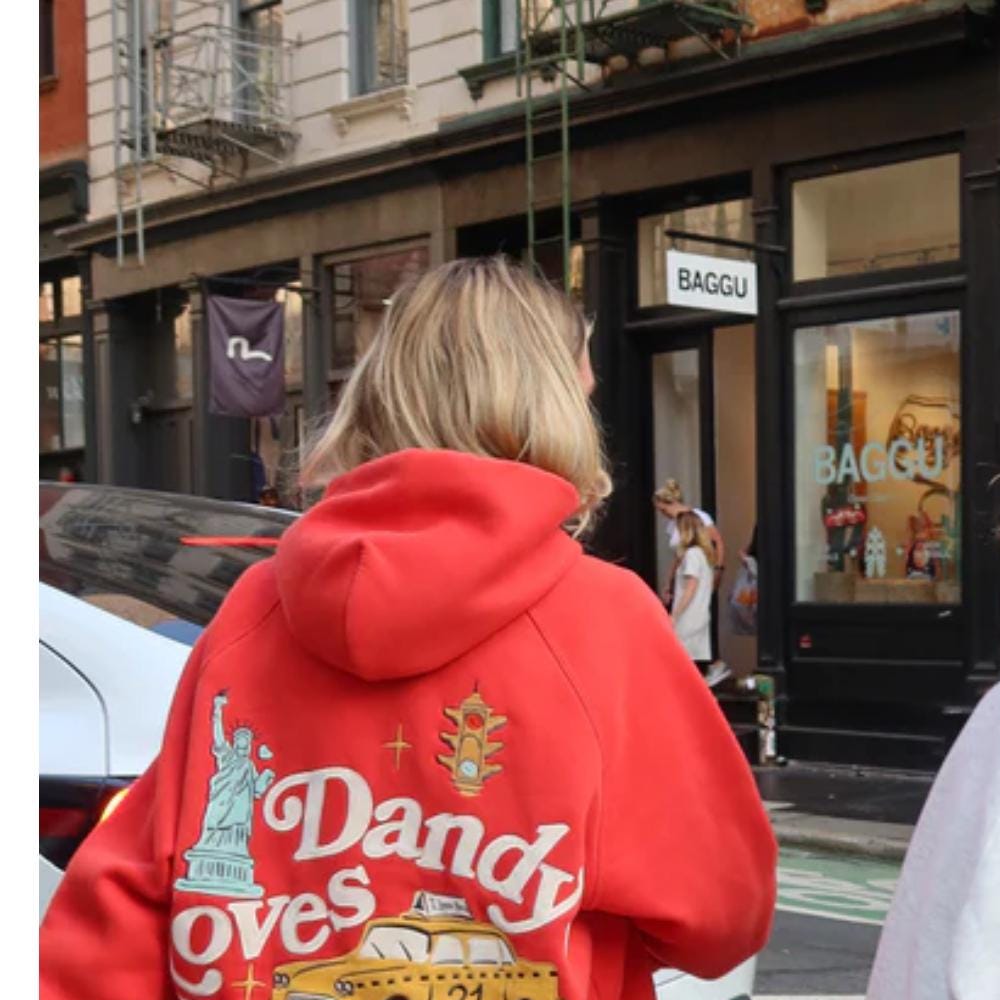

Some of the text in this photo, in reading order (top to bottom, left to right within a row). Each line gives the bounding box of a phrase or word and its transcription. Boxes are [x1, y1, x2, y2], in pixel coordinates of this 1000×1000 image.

[678, 266, 748, 299] BAGGU
[813, 434, 944, 485] BAGGU
[263, 766, 584, 933] Dandy
